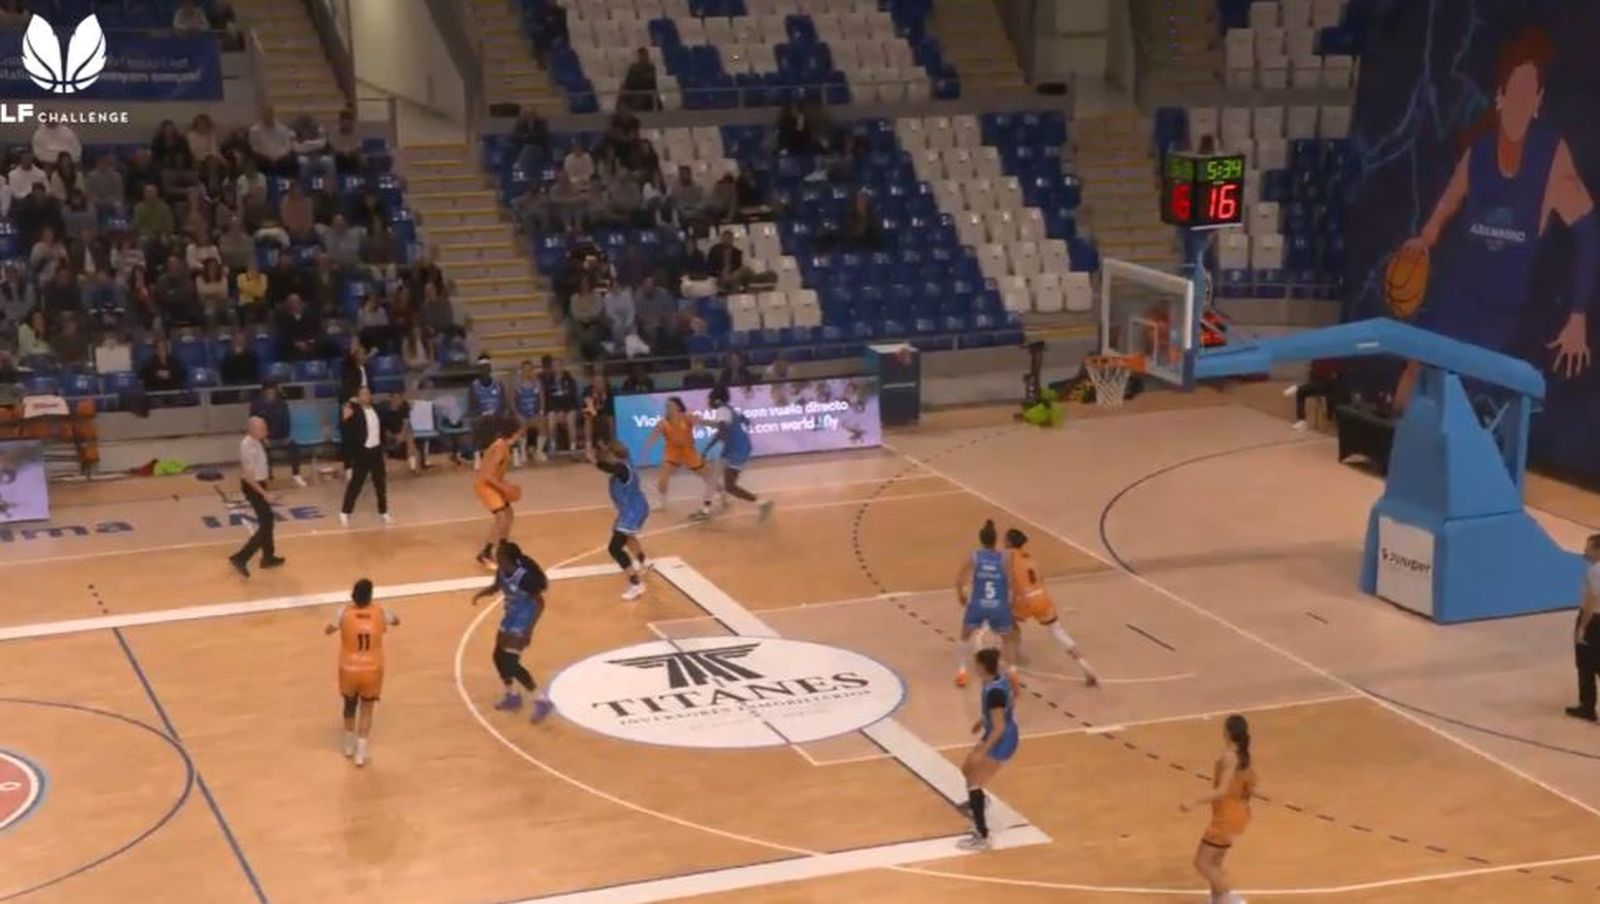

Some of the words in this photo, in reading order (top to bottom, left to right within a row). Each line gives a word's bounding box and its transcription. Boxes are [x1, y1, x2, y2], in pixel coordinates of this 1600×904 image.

[1209, 184, 1237, 218] 16
[769, 404, 803, 417] vuelo
[805, 400, 849, 412] directo
[985, 581, 996, 599] 5
[357, 633, 370, 651] 11
[592, 671, 870, 717] TITANES
